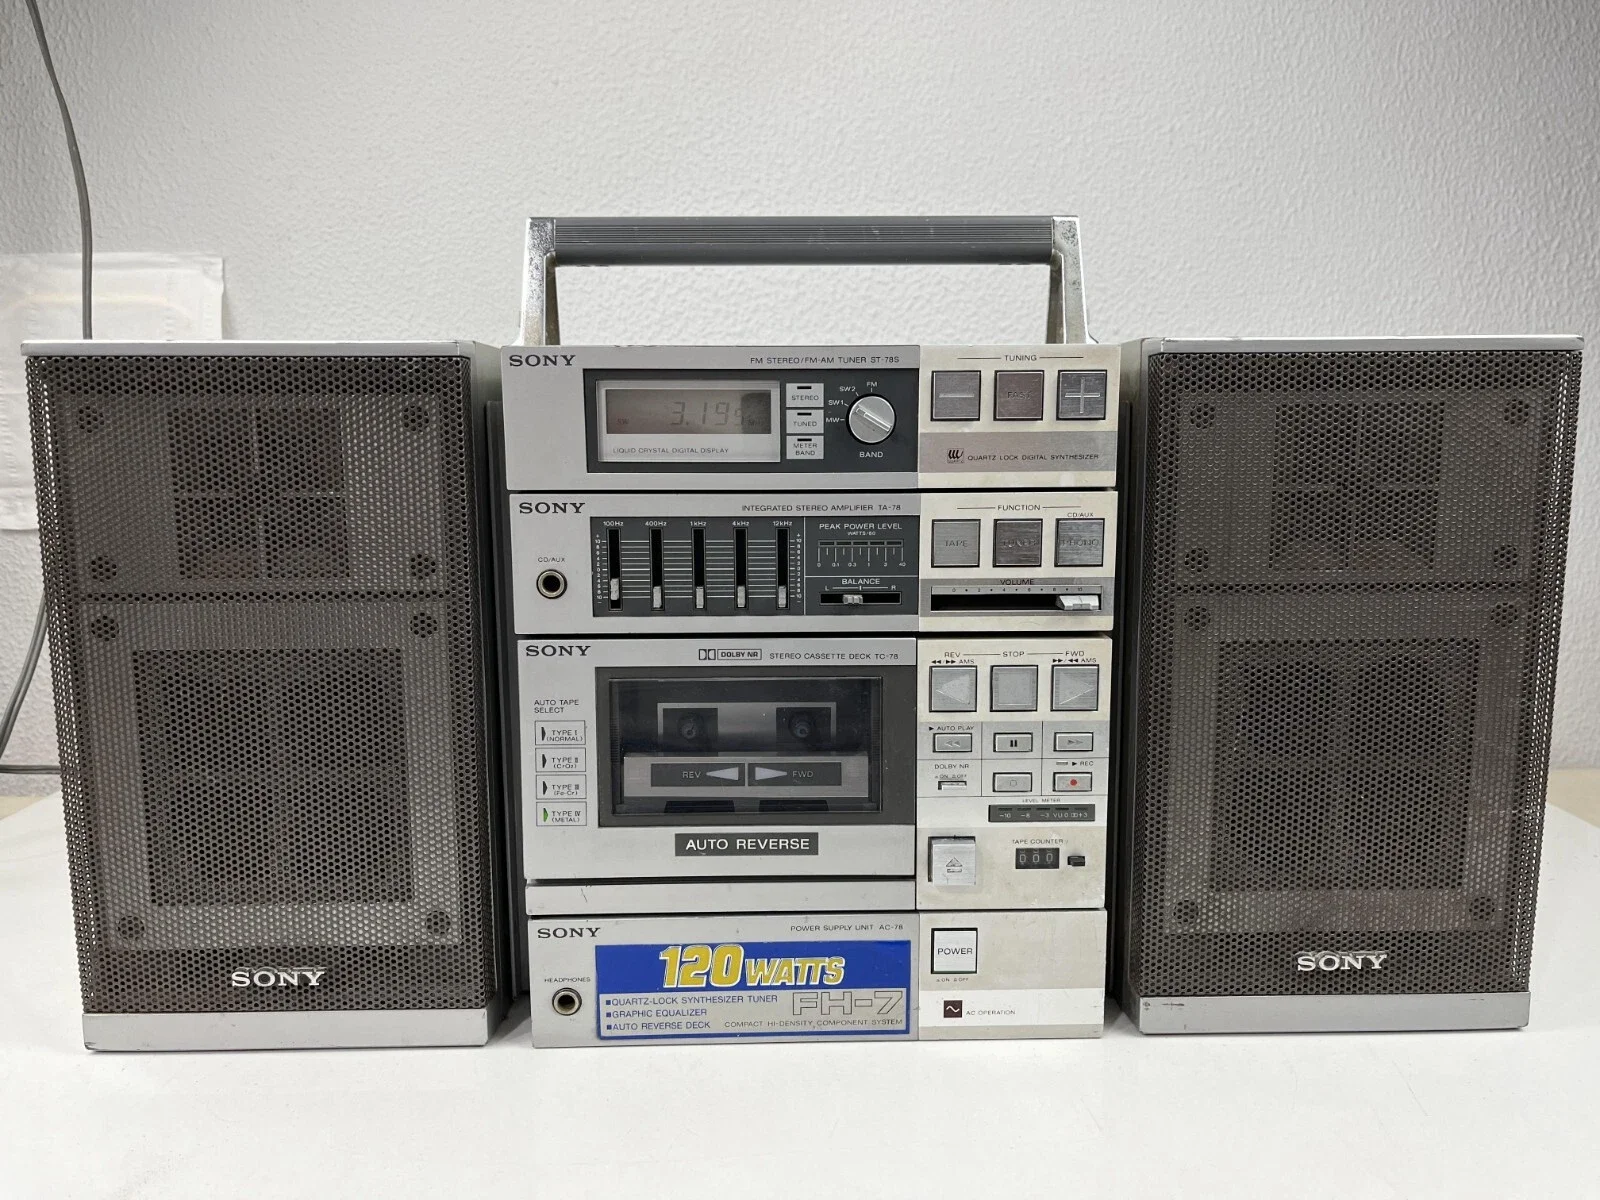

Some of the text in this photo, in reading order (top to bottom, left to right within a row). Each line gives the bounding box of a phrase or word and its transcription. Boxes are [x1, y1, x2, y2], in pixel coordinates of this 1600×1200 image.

[509, 354, 576, 367] SONY
[750, 357, 764, 365] FM
[838, 356, 867, 364] TUNER
[870, 356, 900, 364] ST-78S
[1004, 354, 1037, 362] TUNING
[519, 502, 586, 514] SONY
[945, 540, 969, 548] TAPE
[525, 645, 592, 657] SONY
[769, 652, 802, 660] STEREO
[804, 652, 846, 660] CASSETTE
[848, 652, 871, 660] DECK
[875, 652, 899, 660] TC-78
[944, 651, 961, 659] REV
[1065, 650, 1085, 658] FWD
[534, 706, 564, 714] SELECT
[957, 724, 975, 732] PLAY
[682, 771, 701, 779] REV
[792, 770, 814, 778] FWD
[685, 838, 811, 851] AUTO REVERSE
[537, 927, 601, 938] SONY
[823, 924, 853, 932] SUPPLY
[878, 923, 904, 931] AC-78
[937, 947, 973, 956] POWER
[659, 943, 846, 988] 120 WATTS
[1297, 954, 1388, 971] SONY
[231, 970, 326, 987] SONY
[612, 994, 778, 1006] QUARTZ-LOCK SYNTHESIZER TUNER
[792, 990, 904, 1016] FH-7
[612, 1008, 708, 1018] GRAPHIC EQUALIZER
[612, 1022, 639, 1031] AUTO
[641, 1021, 683, 1030] REVERSE
[685, 1021, 711, 1029] DECK
[724, 1020, 764, 1028] COMPACT
[871, 1018, 903, 1026] SYSTEM
